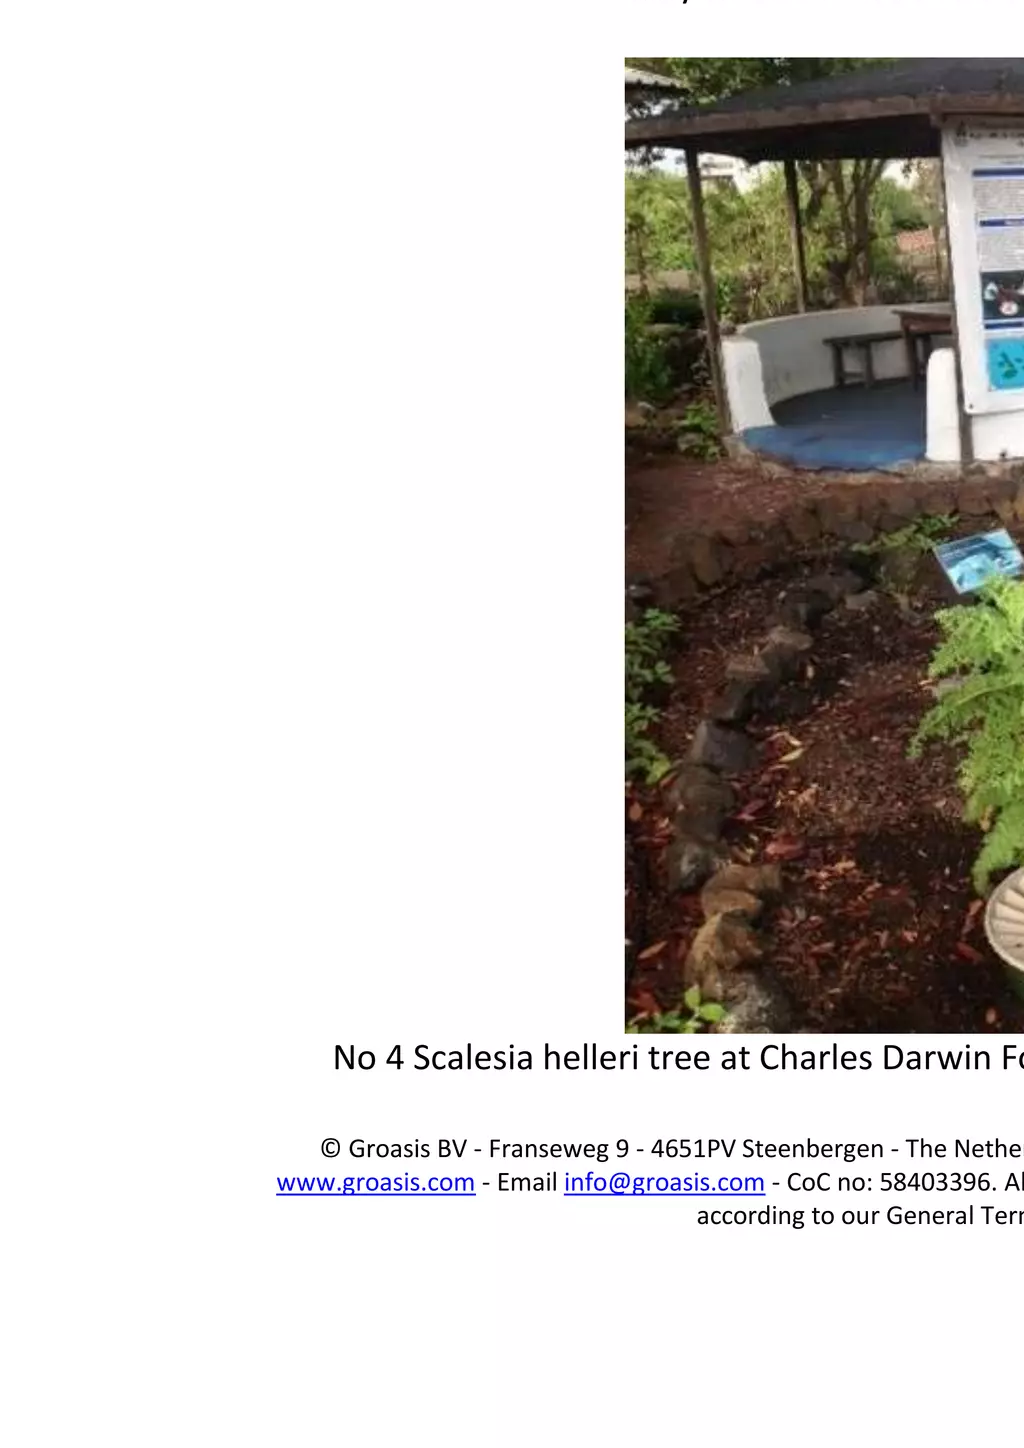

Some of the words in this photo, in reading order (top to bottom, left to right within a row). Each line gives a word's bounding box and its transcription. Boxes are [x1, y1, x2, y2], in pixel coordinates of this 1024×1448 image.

[334, 1044, 376, 1071] No
[385, 1044, 405, 1070] 4
[413, 1042, 533, 1071] Scalesia
[544, 1042, 638, 1071] helleri
[647, 1046, 711, 1071] tree
[720, 1046, 751, 1071] at
[760, 1042, 873, 1071] Charles
[883, 1043, 991, 1071] Darwin
[320, 1137, 341, 1159] ©
[349, 1138, 431, 1159] Groasis
[438, 1138, 468, 1158] BV
[490, 1138, 609, 1163] Franseweg
[616, 1138, 629, 1159] 9
[650, 1138, 737, 1158] 4651PV
[742, 1137, 884, 1163] Steenbergen
[905, 1137, 947, 1159] The
[275, 1171, 477, 1197] www.groasis.com
[498, 1171, 557, 1192] Email
[563, 1170, 767, 1197] info@groasis.com
[787, 1172, 831, 1192] CoC
[838, 1176, 872, 1192] no:
[880, 1172, 997, 1192] 58403396.
[697, 1204, 805, 1230] according
[811, 1207, 835, 1225] to
[841, 1210, 881, 1225] our
[886, 1204, 974, 1225] General
